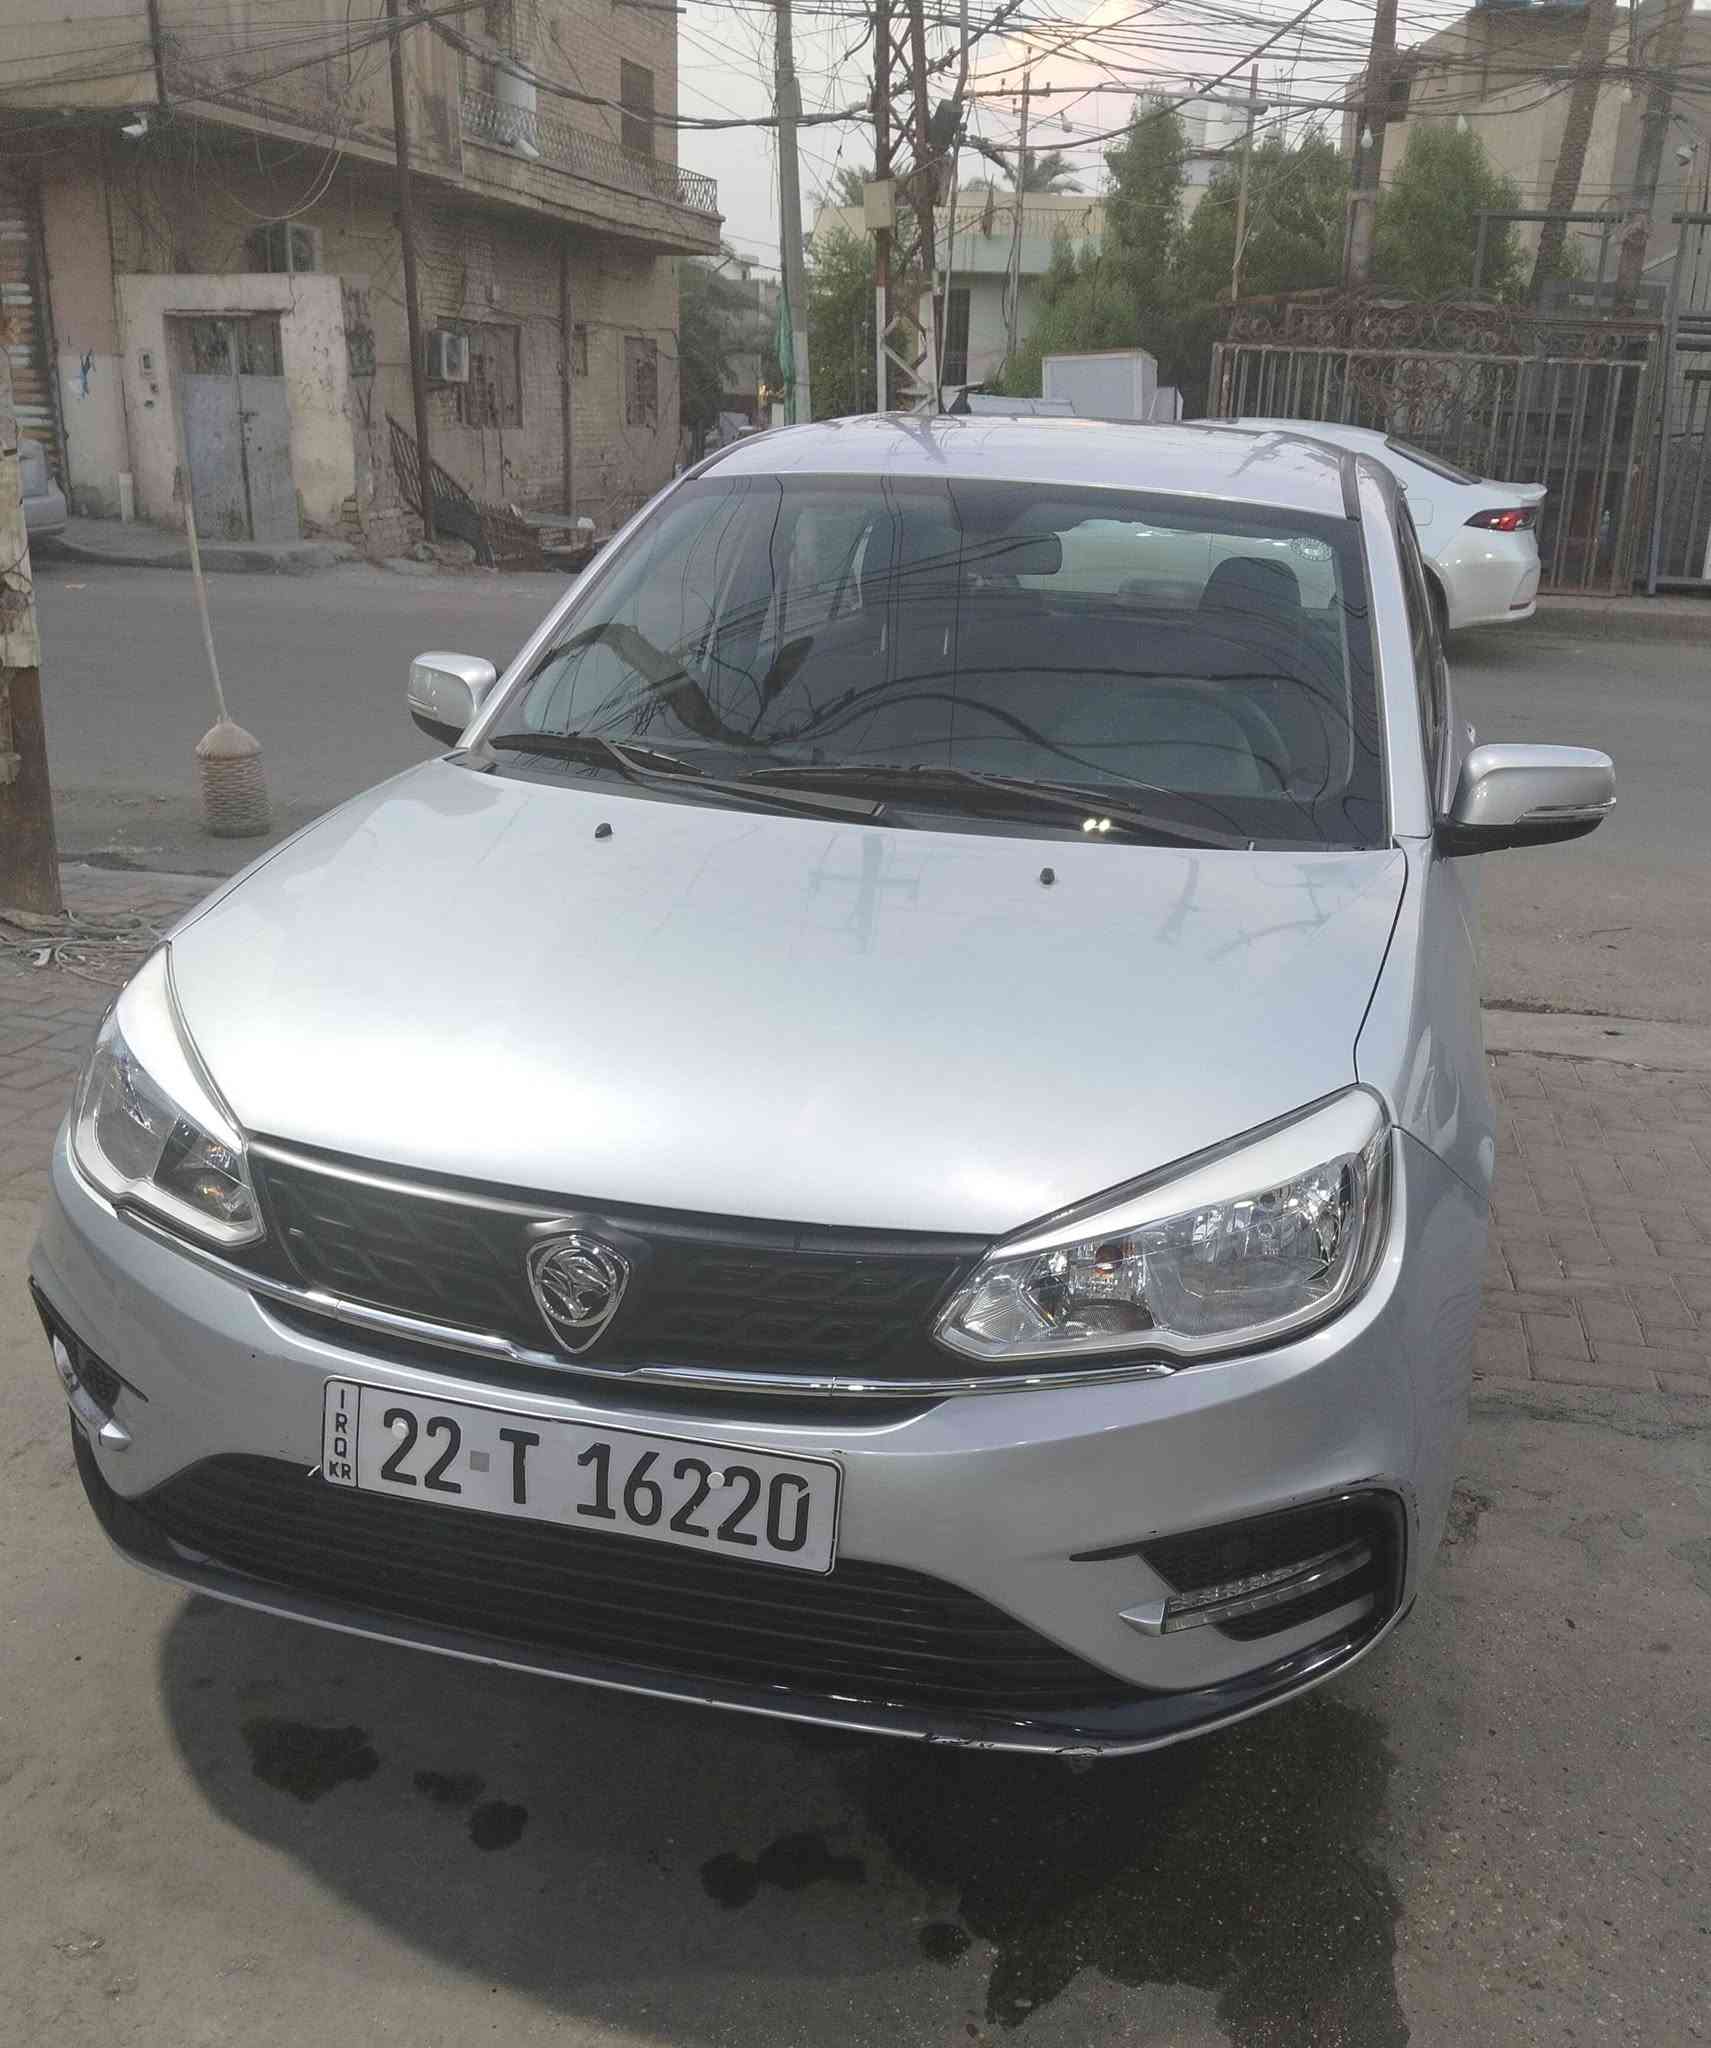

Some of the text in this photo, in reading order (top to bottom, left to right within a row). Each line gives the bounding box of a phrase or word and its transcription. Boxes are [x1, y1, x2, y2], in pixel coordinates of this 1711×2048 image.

[334, 1389, 348, 1459] IRQ
[329, 1461, 351, 1480] KR
[381, 1407, 810, 1552] 22 T 16220
